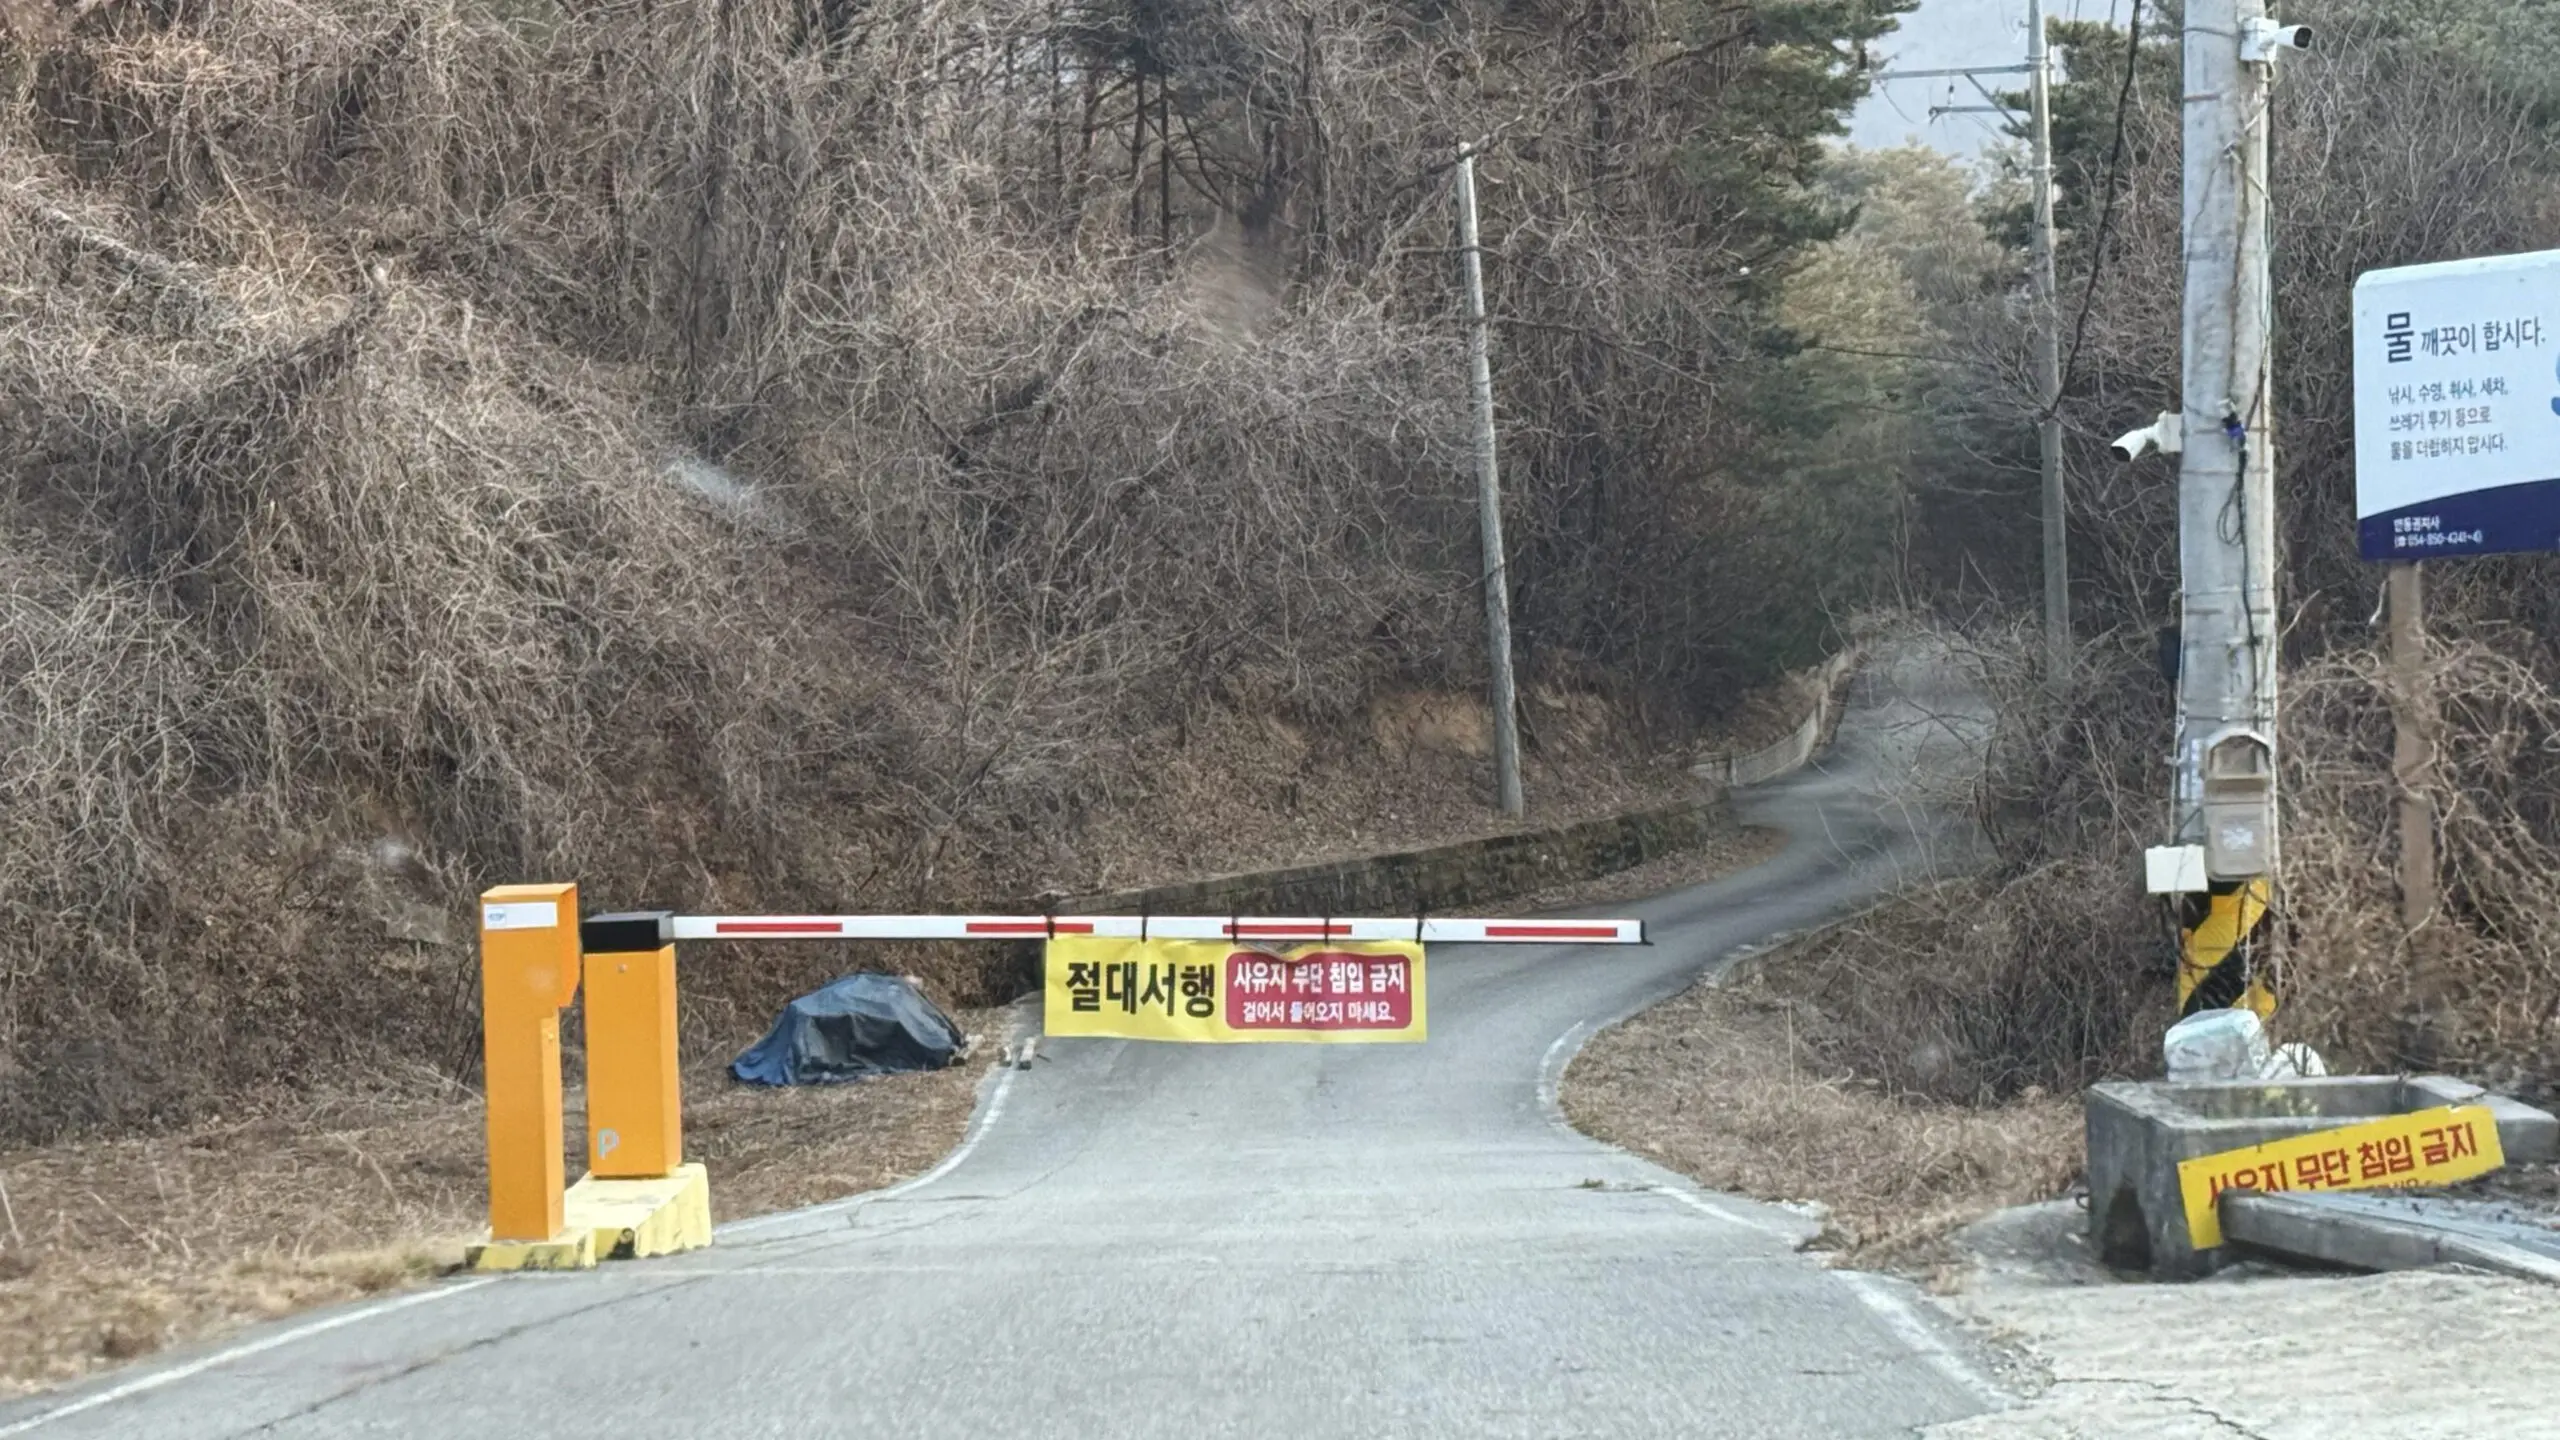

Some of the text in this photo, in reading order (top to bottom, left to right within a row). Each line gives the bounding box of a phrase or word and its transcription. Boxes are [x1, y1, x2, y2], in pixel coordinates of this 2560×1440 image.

[2384, 312, 2546, 363] 물 깨끗이 합시다.
[2389, 406, 2492, 431] 쓰레기 투기 등으로
[2390, 439, 2413, 461] 물을
[2416, 436, 2465, 458] 더럽히지
[1066, 961, 1215, 1018] 절대서행
[1234, 962, 1405, 994] 사유지 무단 침입 금지
[1243, 1001, 1396, 1024] 걸어서 들어오지 마세요.
[2296, 1147, 2351, 1190] 무단
[2357, 1135, 2416, 1180] 침입
[2420, 1121, 2478, 1167] 금지
